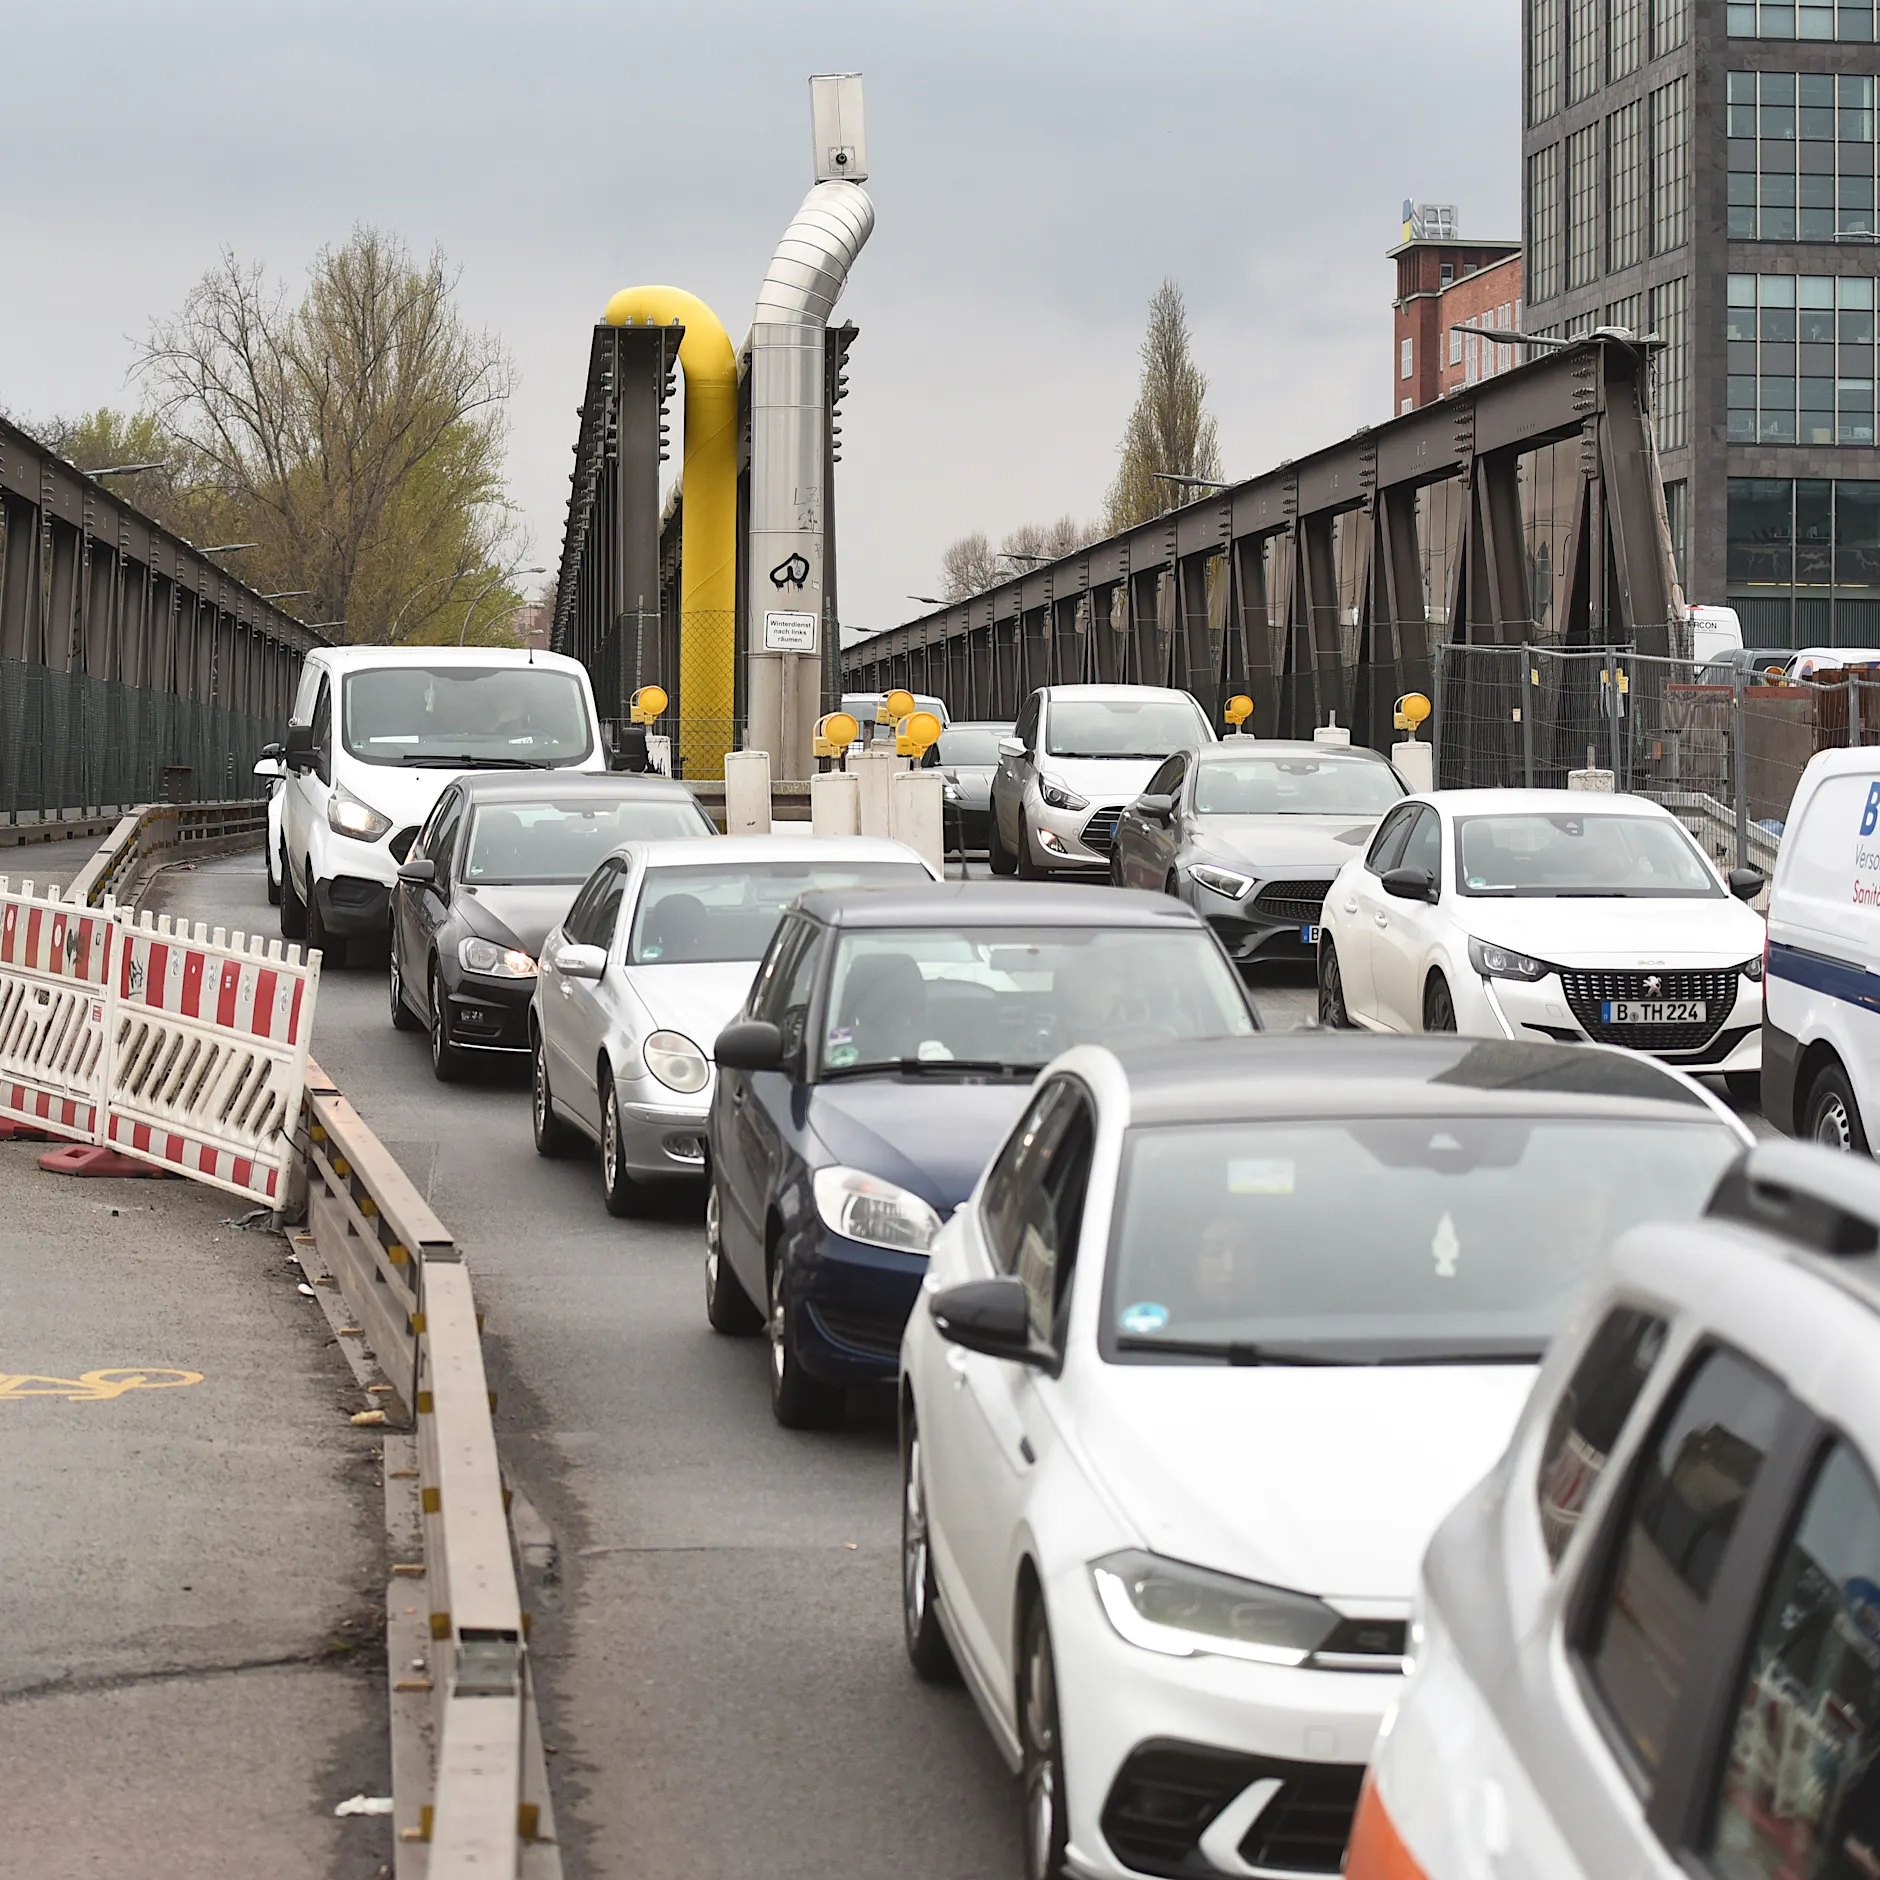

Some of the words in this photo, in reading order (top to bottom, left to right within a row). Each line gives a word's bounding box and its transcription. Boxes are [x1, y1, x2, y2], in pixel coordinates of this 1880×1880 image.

[770, 620, 811, 628] Winterdienst
[791, 628, 807, 636] links
[777, 636, 803, 644] räumen
[1855, 843, 1880, 870] Verso
[1311, 927, 1320, 941] B
[1617, 1004, 1628, 1020] B
[1641, 1004, 1662, 1020] TH
[1666, 1003, 1698, 1020] 224
